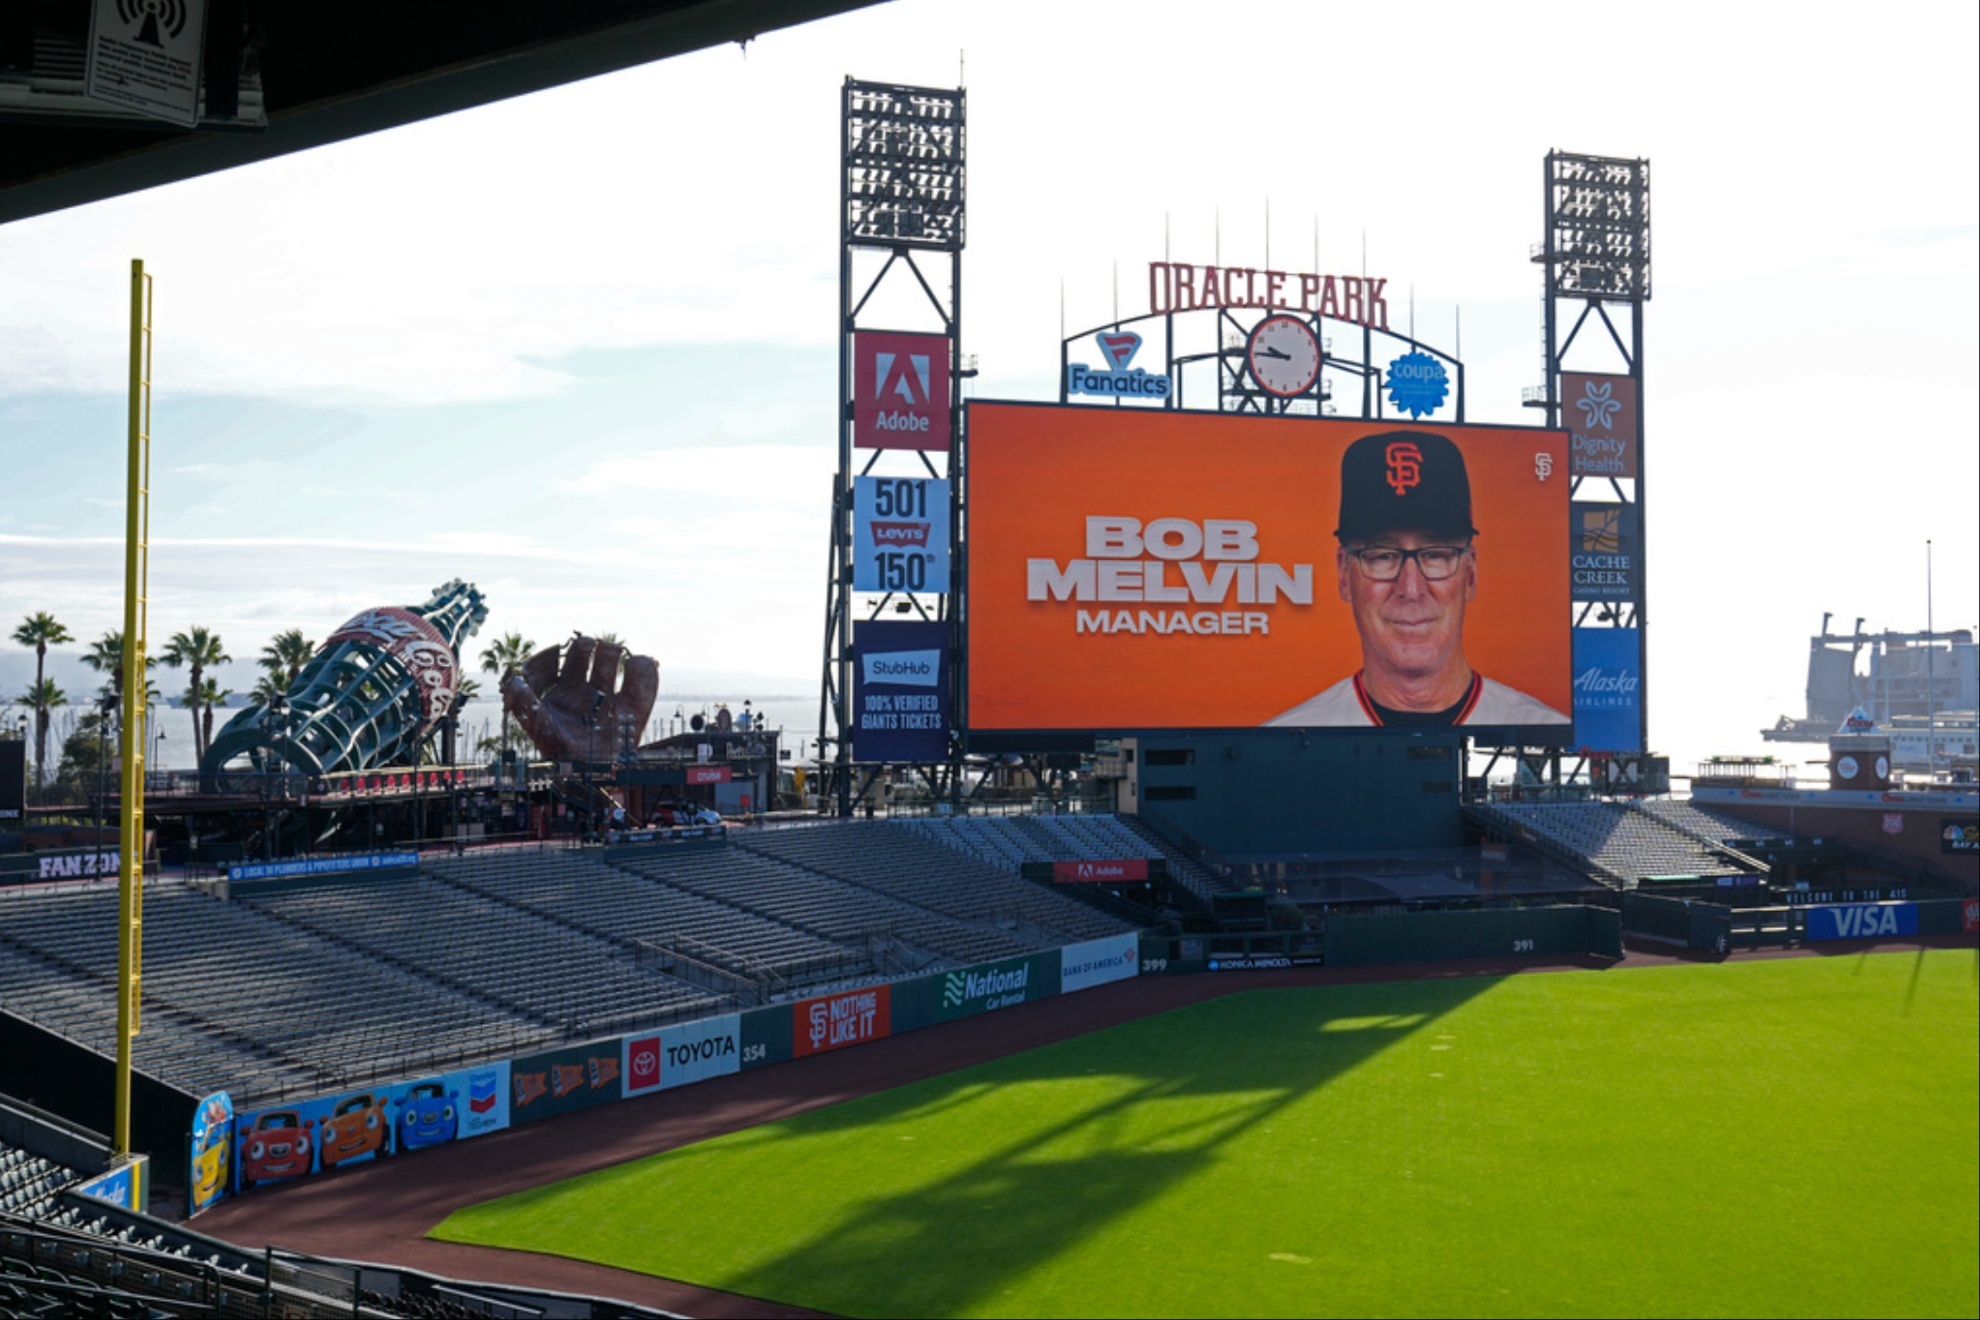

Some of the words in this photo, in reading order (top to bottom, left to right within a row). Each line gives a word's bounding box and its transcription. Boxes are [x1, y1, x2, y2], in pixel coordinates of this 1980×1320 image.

[1149, 261, 1287, 315] ORACLE
[1300, 273, 1389, 332] PARK
[1072, 368, 1168, 395] Fanatics
[1394, 363, 1444, 384] coupa
[876, 411, 930, 432] Adobe
[1572, 434, 1626, 456] Dignity
[1575, 456, 1624, 472] Health
[875, 479, 927, 518] 501
[1085, 515, 1260, 561] BOB
[1572, 555, 1630, 569] CACHE
[1026, 558, 1313, 605] MELVIN
[1574, 571, 1628, 584] CREEK
[1076, 609, 1269, 635] MANAGER
[873, 660, 930, 676] StubHub
[1574, 667, 1639, 695] Alaska
[865, 694, 893, 712] 100%
[894, 694, 938, 712] VERIFIED
[861, 714, 898, 729] GIANTS
[900, 714, 942, 729] TICKETS
[39, 855, 82, 878] FAN
[85, 852, 121, 875] ZON
[1096, 866, 1124, 876] Adobe
[1828, 906, 1898, 937] VISA
[1513, 938, 1534, 952] 391
[1063, 966, 1082, 977] BANK
[1084, 963, 1093, 973] OF
[1094, 956, 1123, 969] AMERICA
[1142, 958, 1167, 971] 399
[1219, 960, 1253, 970] KONICA
[1254, 958, 1292, 968] MINOLTA
[964, 961, 1029, 1000] National
[830, 992, 876, 1022] NOTHING
[830, 1015, 857, 1044] LIKE
[860, 1009, 876, 1038] IT
[667, 1035, 735, 1067] TOYOTA
[743, 1043, 766, 1062] 354
